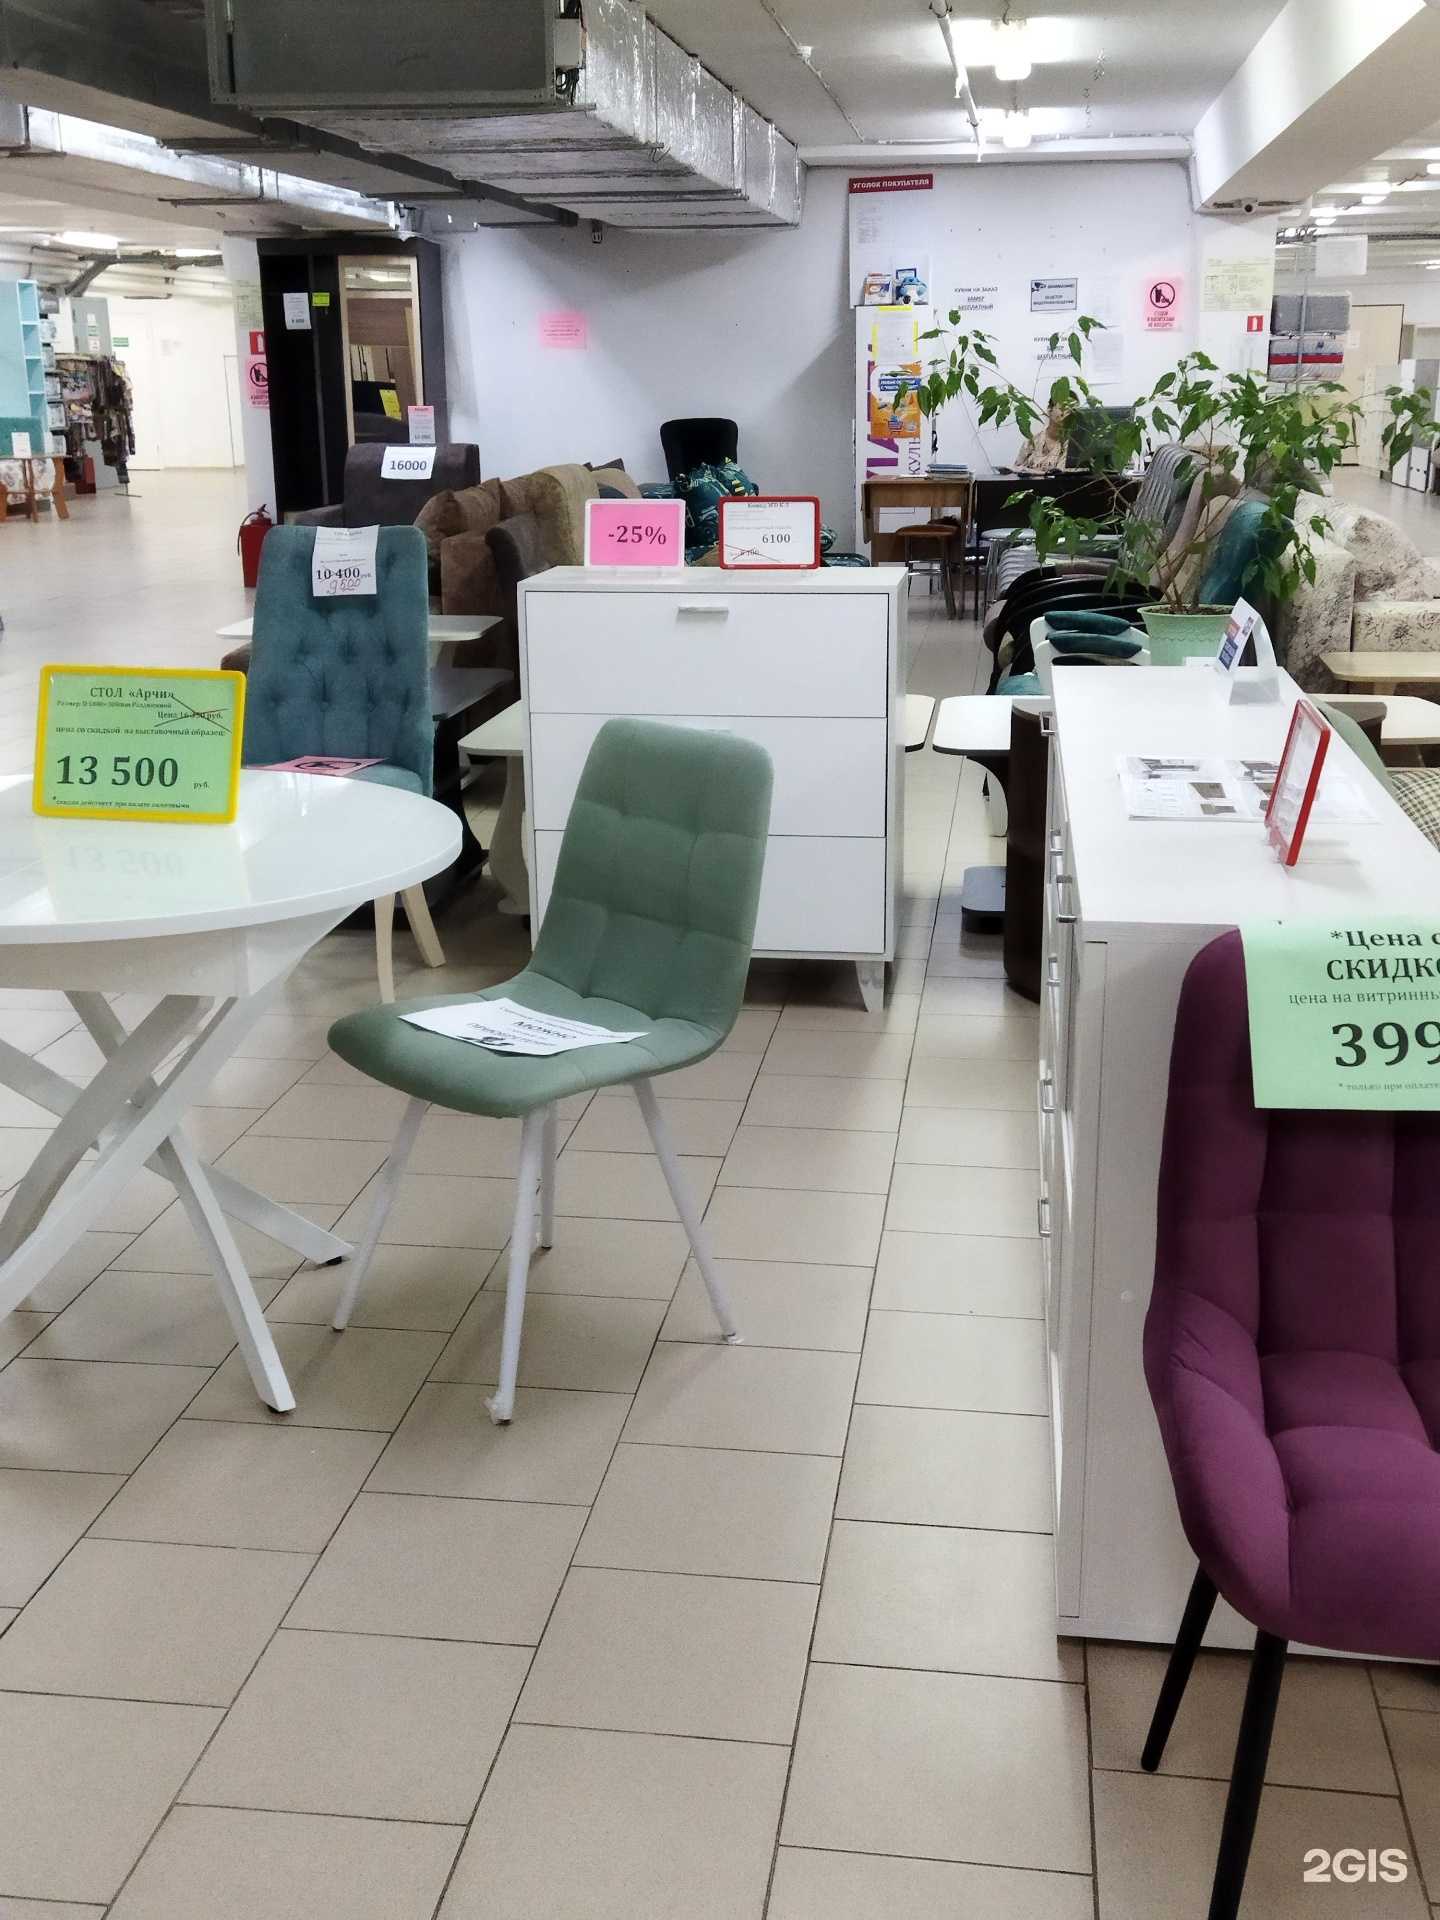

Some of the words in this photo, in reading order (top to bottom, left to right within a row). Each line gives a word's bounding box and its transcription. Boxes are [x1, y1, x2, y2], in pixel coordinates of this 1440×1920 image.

[852, 181, 881, 189] УГОЛОК
[882, 178, 930, 187] ПОКУПАТЕЛЯ
[390, 460, 427, 471] 16000
[608, 525, 667, 546] -25%
[762, 534, 791, 544] 6100
[316, 568, 332, 580] 10
[335, 567, 360, 579] 400
[90, 687, 123, 698] СТОЛ
[128, 688, 175, 701] «Арчи»
[157, 711, 178, 720] Цена
[87, 726, 121, 734] скидкой
[135, 728, 190, 736] выставочный
[56, 755, 98, 785] 13
[111, 755, 179, 788] 500
[193, 781, 210, 789] руб.
[1326, 957, 1440, 983] СКИДК
[1289, 993, 1328, 1006] цена
[1332, 992, 1352, 1004] на
